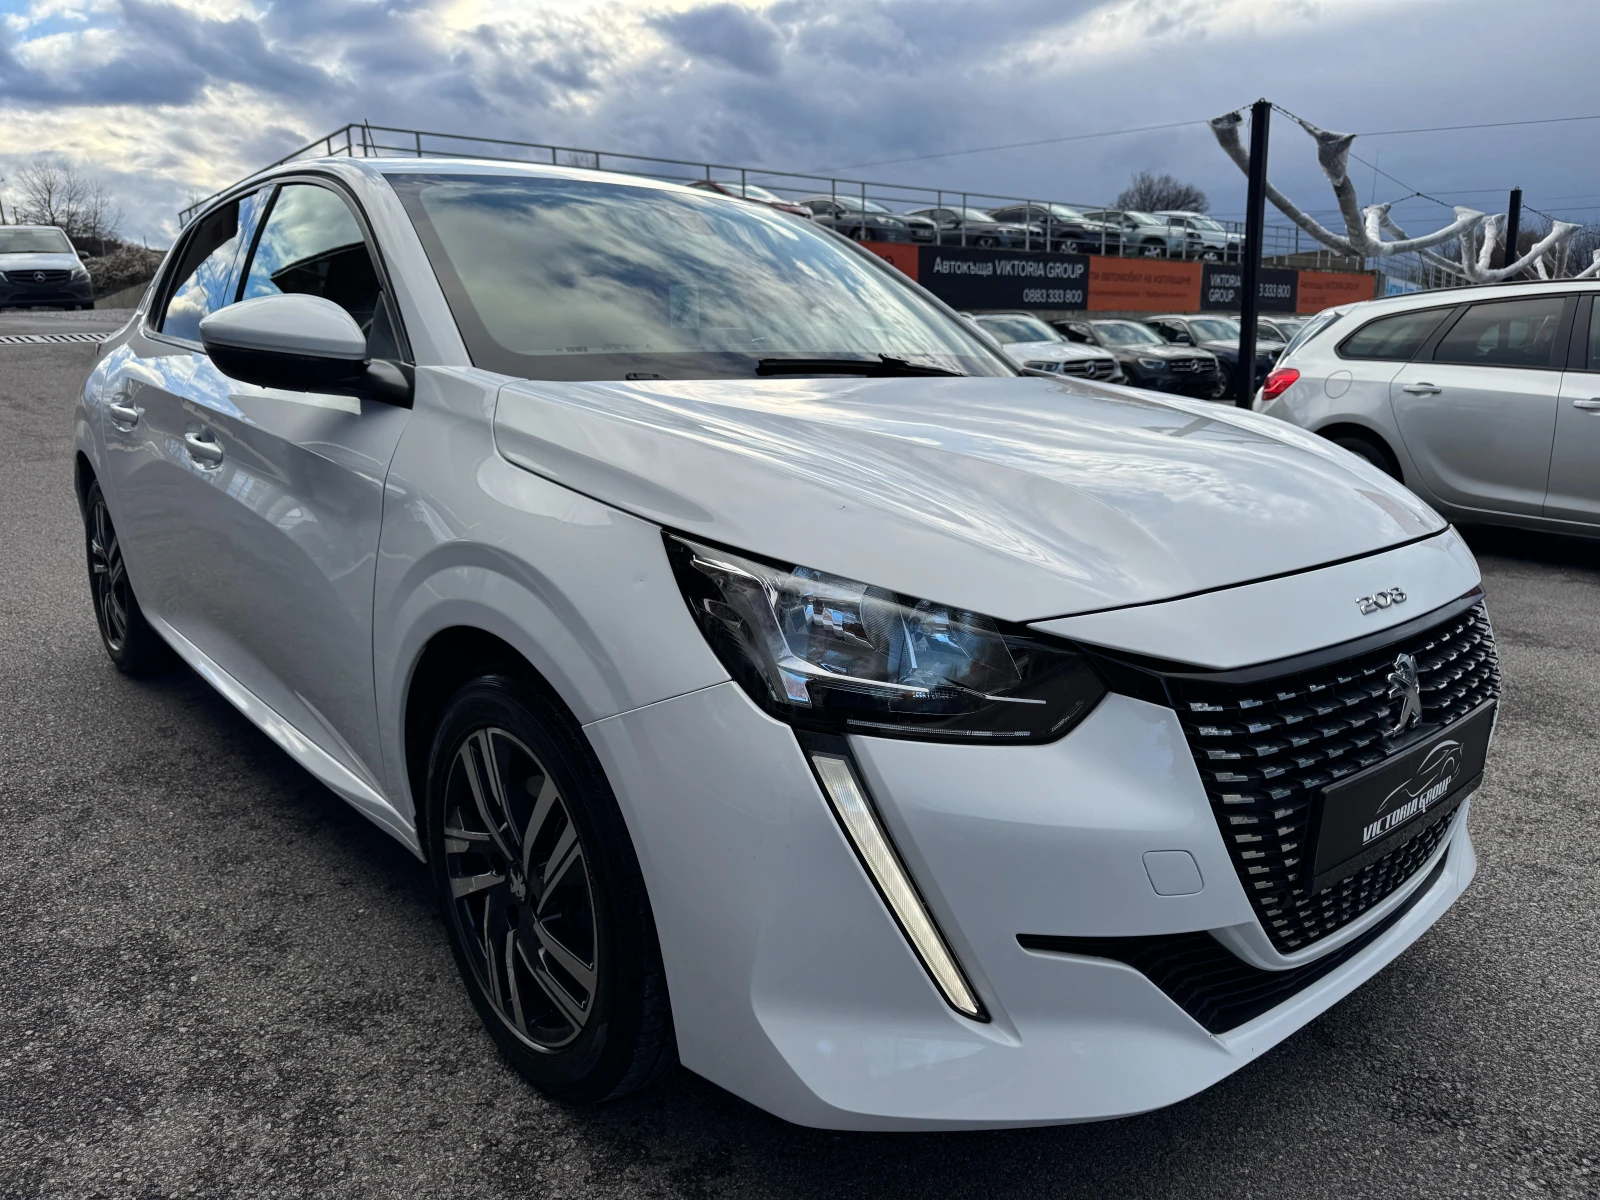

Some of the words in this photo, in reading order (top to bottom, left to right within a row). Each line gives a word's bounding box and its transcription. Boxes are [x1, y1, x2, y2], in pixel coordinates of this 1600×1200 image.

[933, 256, 993, 277] Автокъща
[995, 259, 1046, 277] VIKTORIA
[1046, 263, 1084, 279] GROUP
[1210, 273, 1241, 288] VIKTORIA
[1023, 288, 1046, 302] 0883
[1047, 290, 1064, 303] 333
[1064, 290, 1083, 303] 800
[1208, 288, 1235, 303] GROUP
[1355, 587, 1407, 616] 208
[1362, 802, 1418, 843] VICTORIA
[1418, 775, 1452, 813] GROUP
